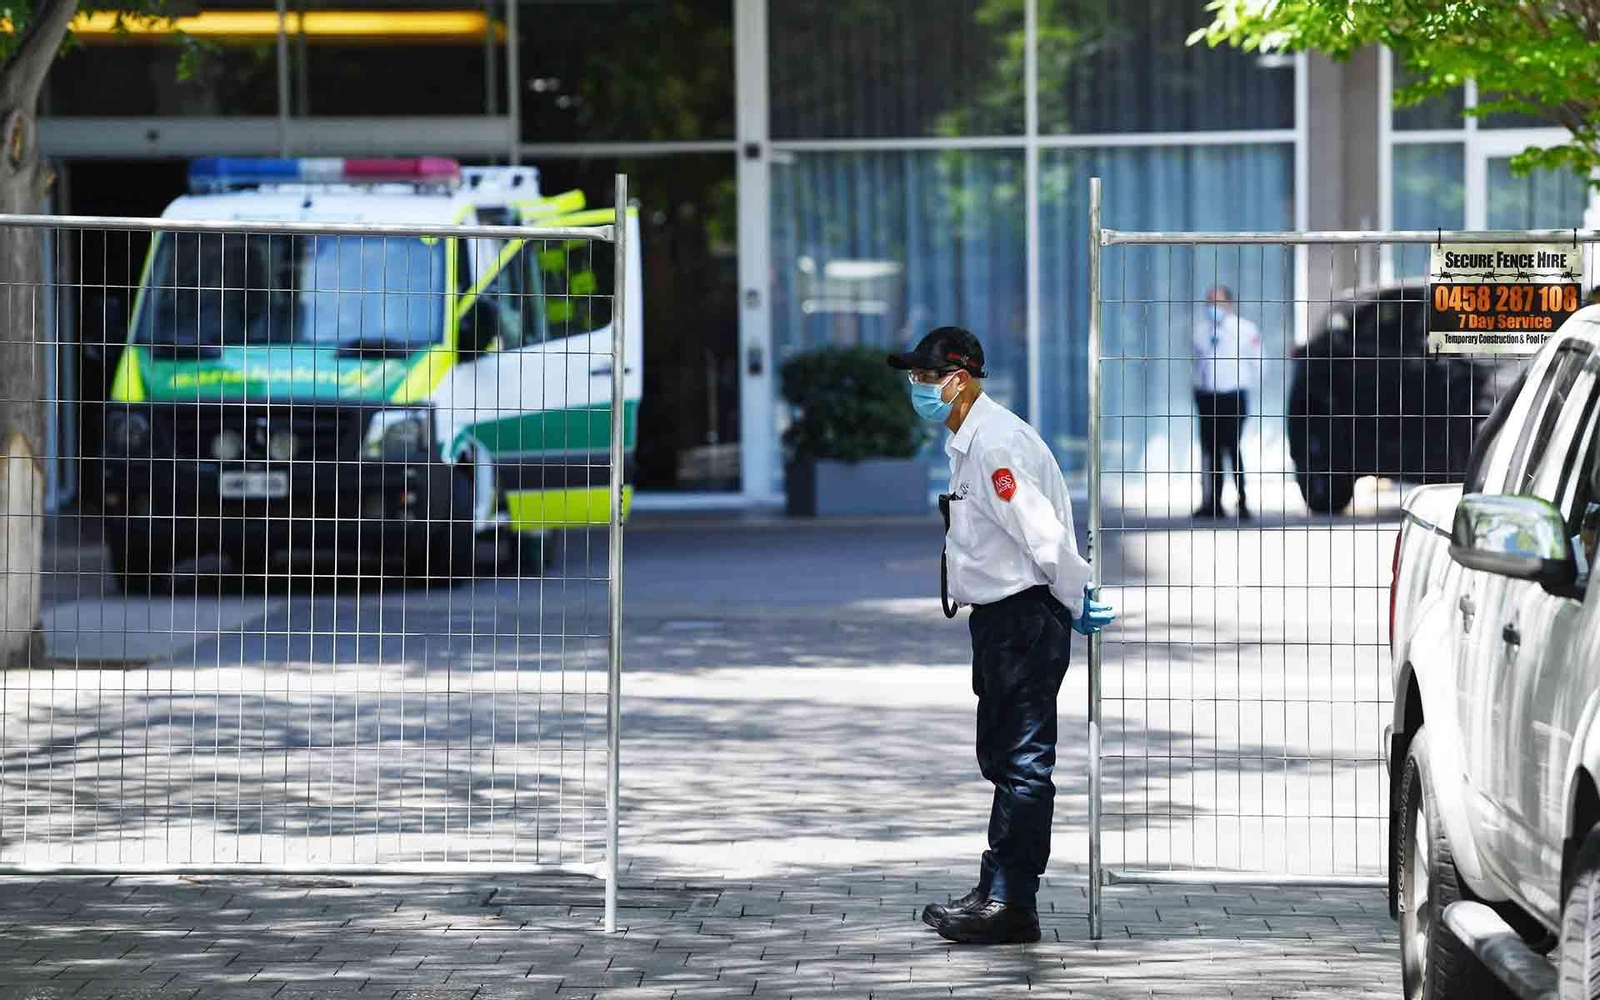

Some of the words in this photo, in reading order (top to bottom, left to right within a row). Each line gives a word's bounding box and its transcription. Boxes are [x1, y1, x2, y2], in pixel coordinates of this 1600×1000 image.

[1445, 251, 1494, 268] SECURE
[1496, 251, 1535, 268] FENCE
[1537, 251, 1567, 268] HIRE
[1434, 285, 1491, 312] 0458
[1494, 285, 1534, 312] 287
[1538, 285, 1578, 312] 108
[1458, 314, 1466, 329] 7
[1468, 314, 1495, 330] Day
[1497, 314, 1553, 329] Service
[1445, 334, 1478, 344] Temporary
[1479, 334, 1519, 344] Construction
[1519, 334, 1525, 344] &
[1526, 334, 1540, 344] Pool
